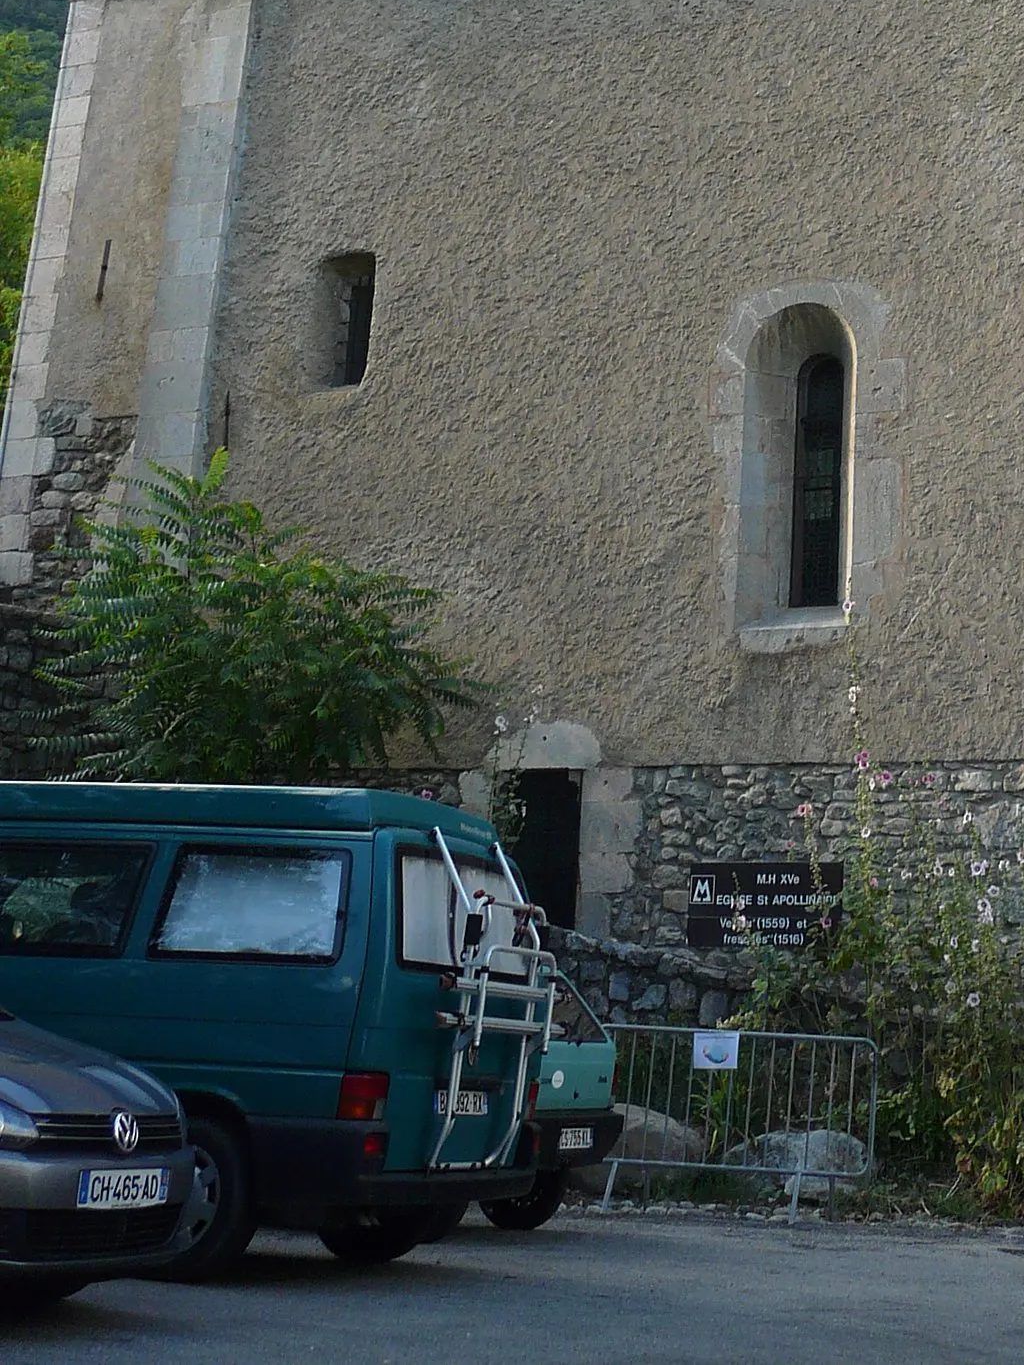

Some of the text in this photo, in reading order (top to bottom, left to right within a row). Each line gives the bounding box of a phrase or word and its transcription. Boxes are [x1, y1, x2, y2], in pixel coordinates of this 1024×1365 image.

[756, 874, 800, 884] M.H XVe
[757, 894, 768, 906] St
[796, 918, 807, 928] et
[91, 1175, 159, 1202] CH-465-AD
